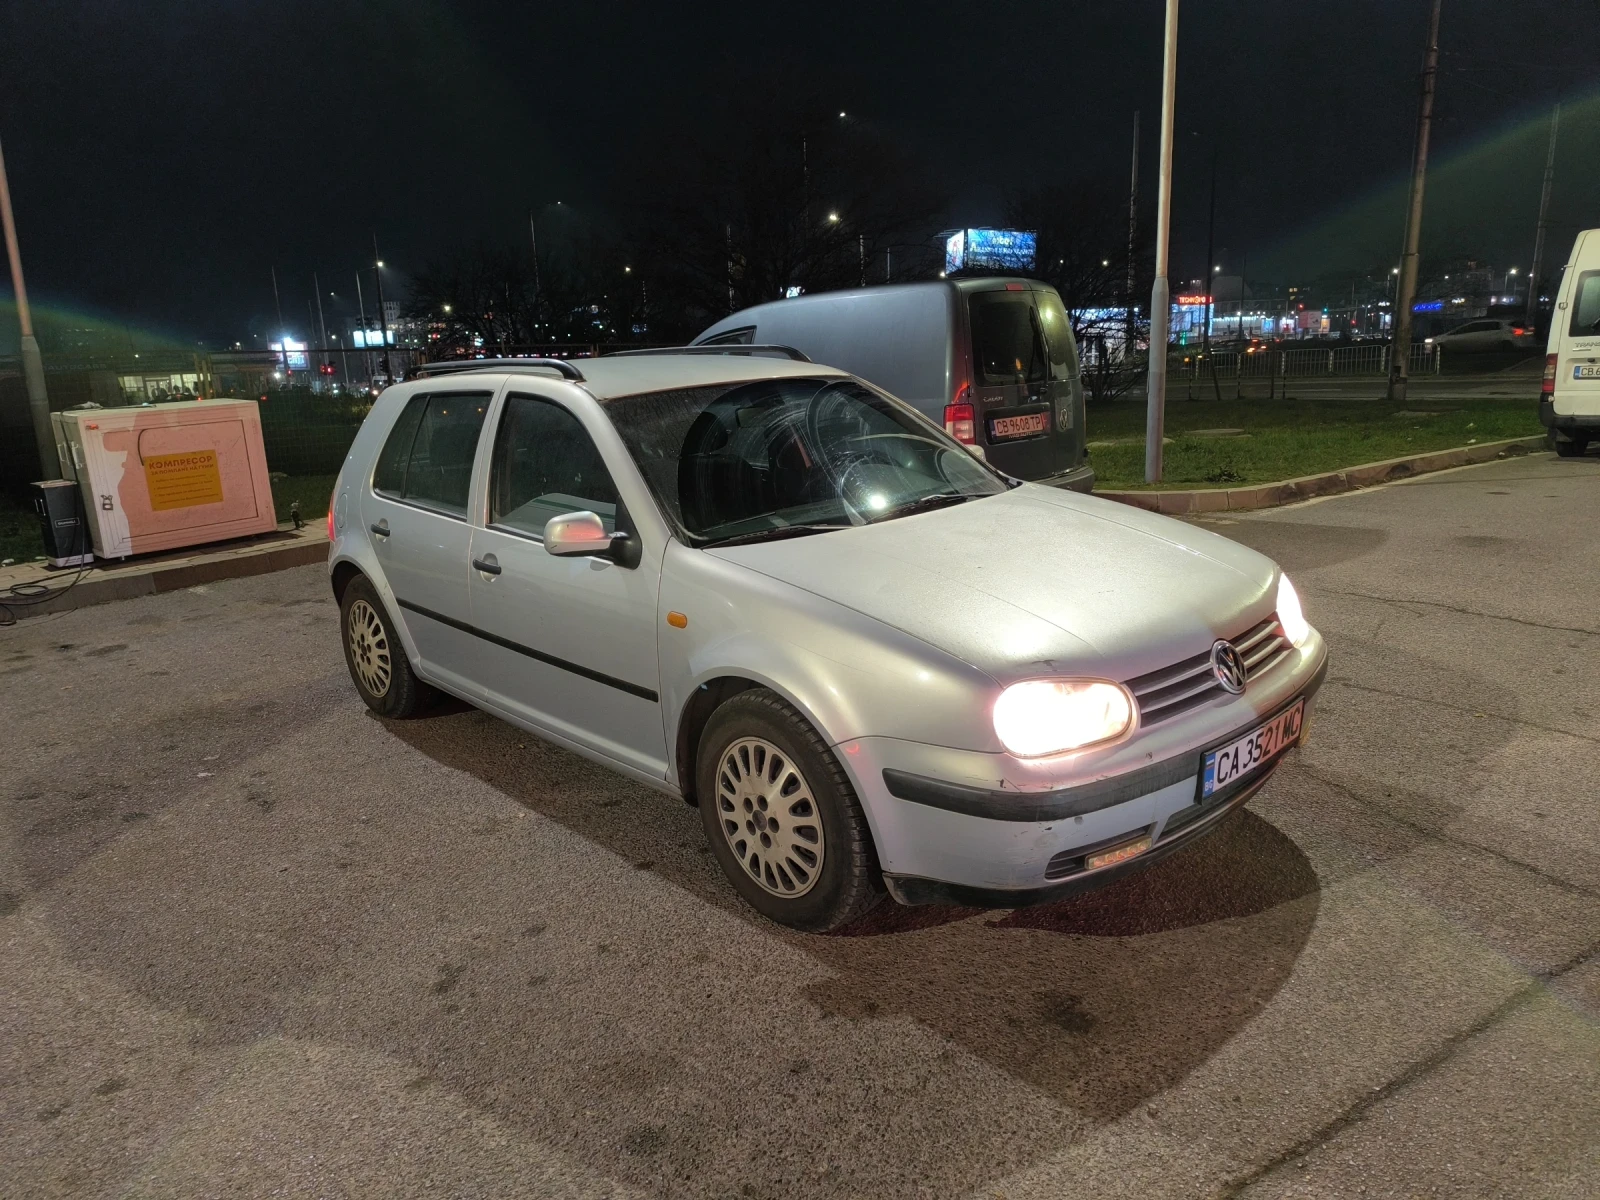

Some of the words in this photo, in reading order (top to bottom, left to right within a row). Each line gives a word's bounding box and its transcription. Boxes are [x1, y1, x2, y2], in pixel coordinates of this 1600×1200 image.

[996, 420, 1009, 434] CB
[1009, 417, 1030, 432] 9608
[1030, 416, 1041, 429] TP
[149, 455, 213, 470] КОМПРЕСОР
[1217, 746, 1239, 784] CA
[1242, 720, 1281, 769] 3521
[1281, 706, 1300, 745] MC
[1204, 779, 1213, 792] BG
